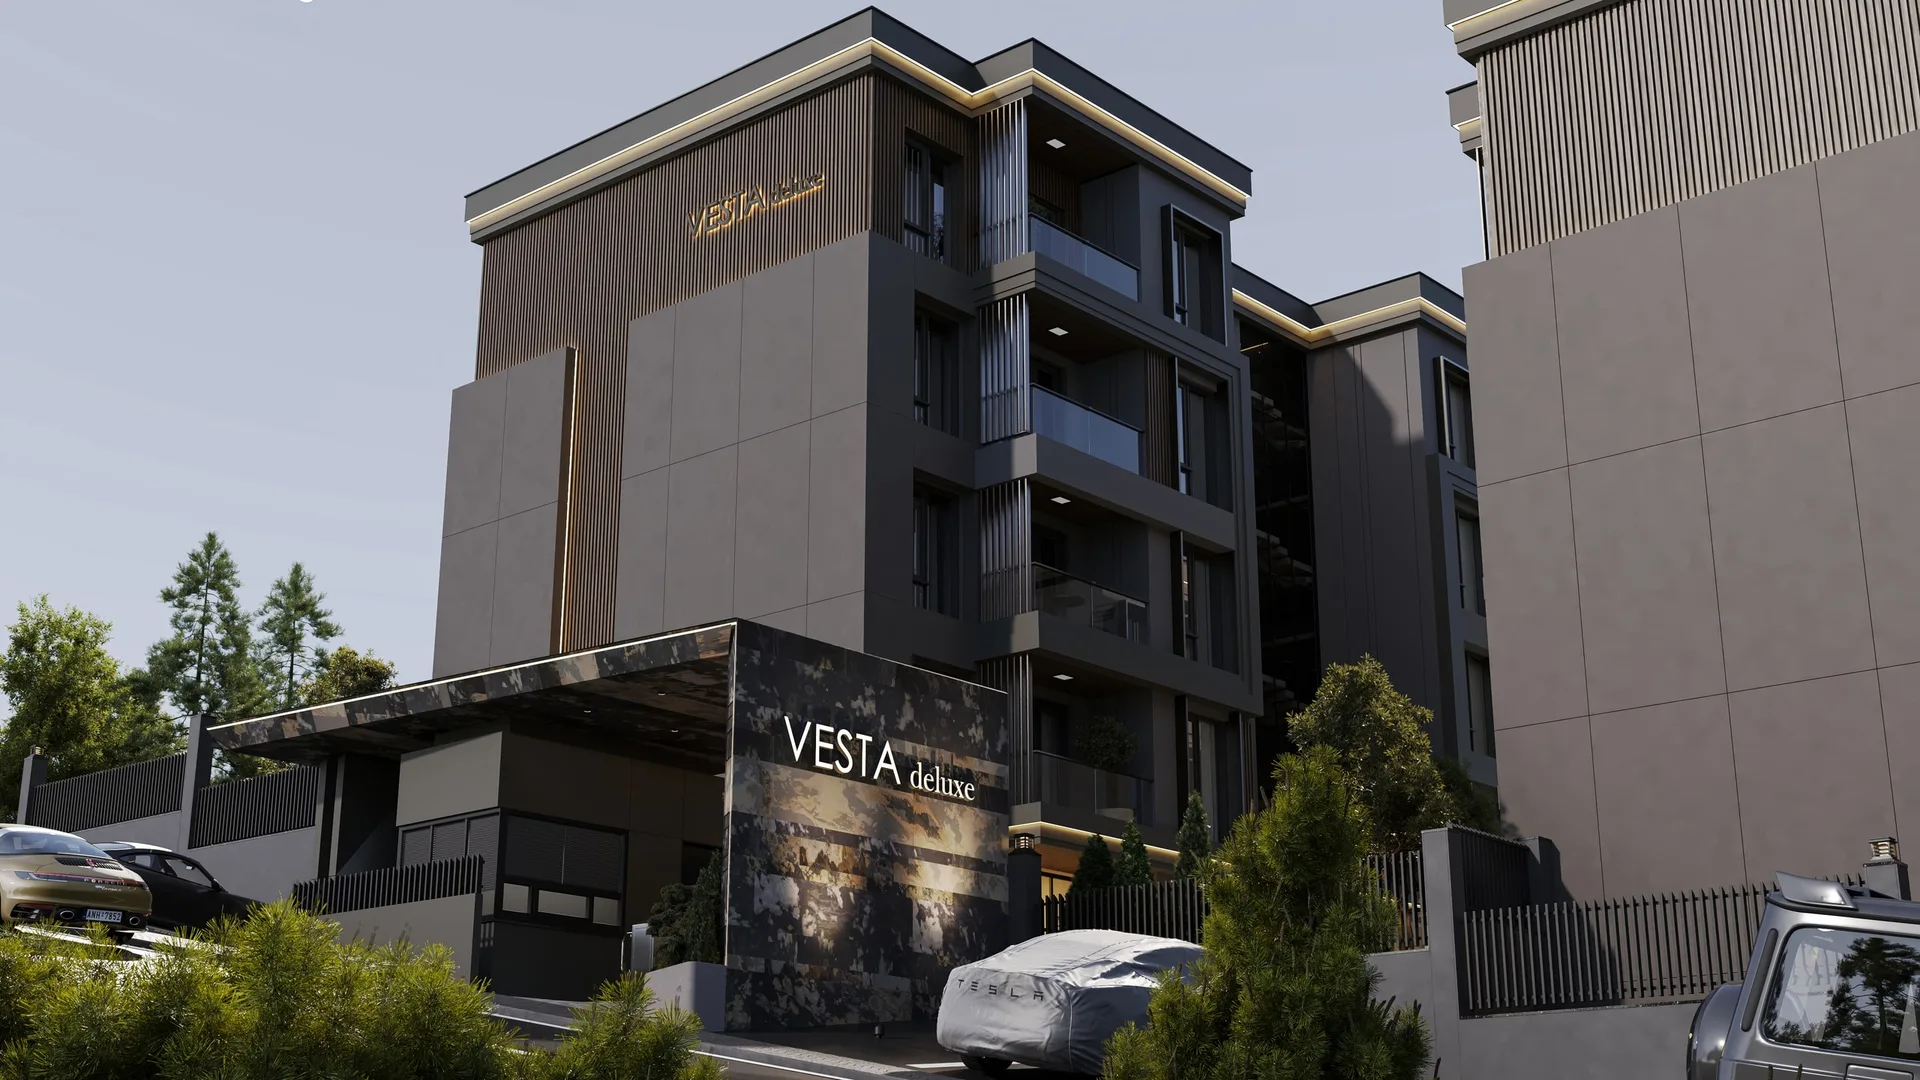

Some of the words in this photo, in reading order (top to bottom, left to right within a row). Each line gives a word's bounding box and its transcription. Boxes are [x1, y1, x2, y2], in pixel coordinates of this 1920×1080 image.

[685, 184, 766, 238] VESTA
[771, 172, 825, 205] deluxe
[784, 715, 901, 785] VESTA
[910, 762, 976, 801] deluxe
[957, 979, 1044, 1001] TESLA
